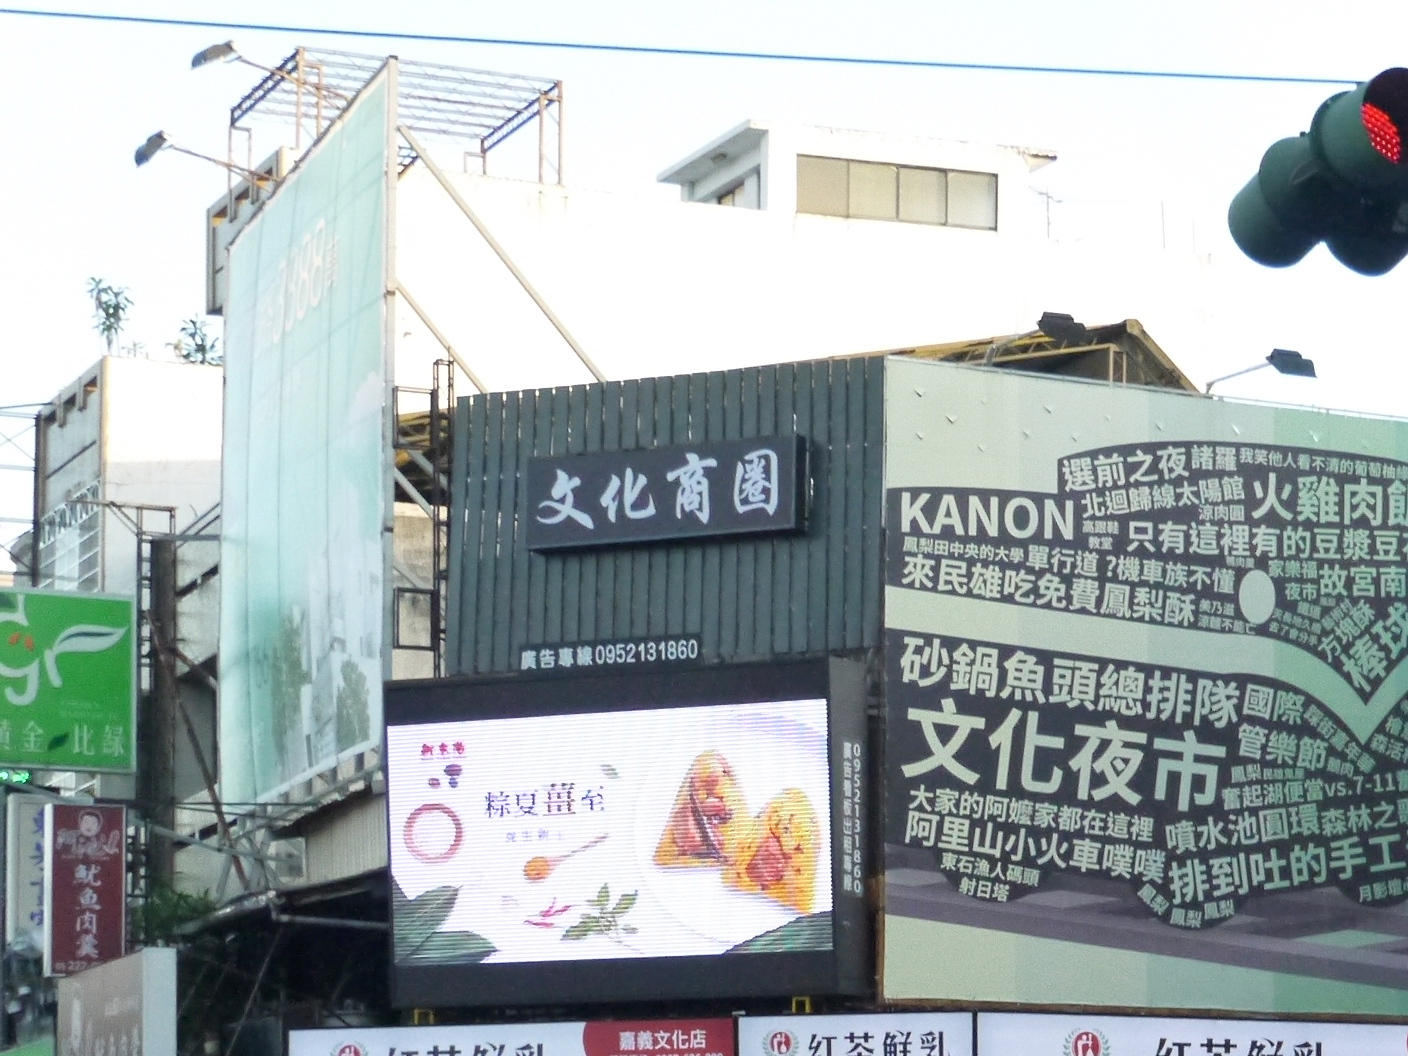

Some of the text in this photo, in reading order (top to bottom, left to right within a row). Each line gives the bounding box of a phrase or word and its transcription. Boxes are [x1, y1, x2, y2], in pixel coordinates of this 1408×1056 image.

[536, 449, 779, 530] 文化商圈
[1063, 446, 1190, 492] 選前之夜
[901, 491, 1074, 541] KANON
[903, 537, 1025, 564] 鳳梨田中央的大學
[901, 554, 1196, 627] 來民雄吃免費鳳梨酥
[1285, 582, 1318, 601] 夜市
[901, 636, 1240, 728] 砂鍋魚頭總排隊
[1242, 683, 1305, 725] 國際
[901, 698, 1226, 812] 文化夜市
[1238, 723, 1329, 771] 管樂節
[853, 743, 862, 894] 0952131860
[909, 784, 1154, 842] 大家的阿嬤家都在這裡
[619, 1029, 706, 1050] 嘉義文化店
